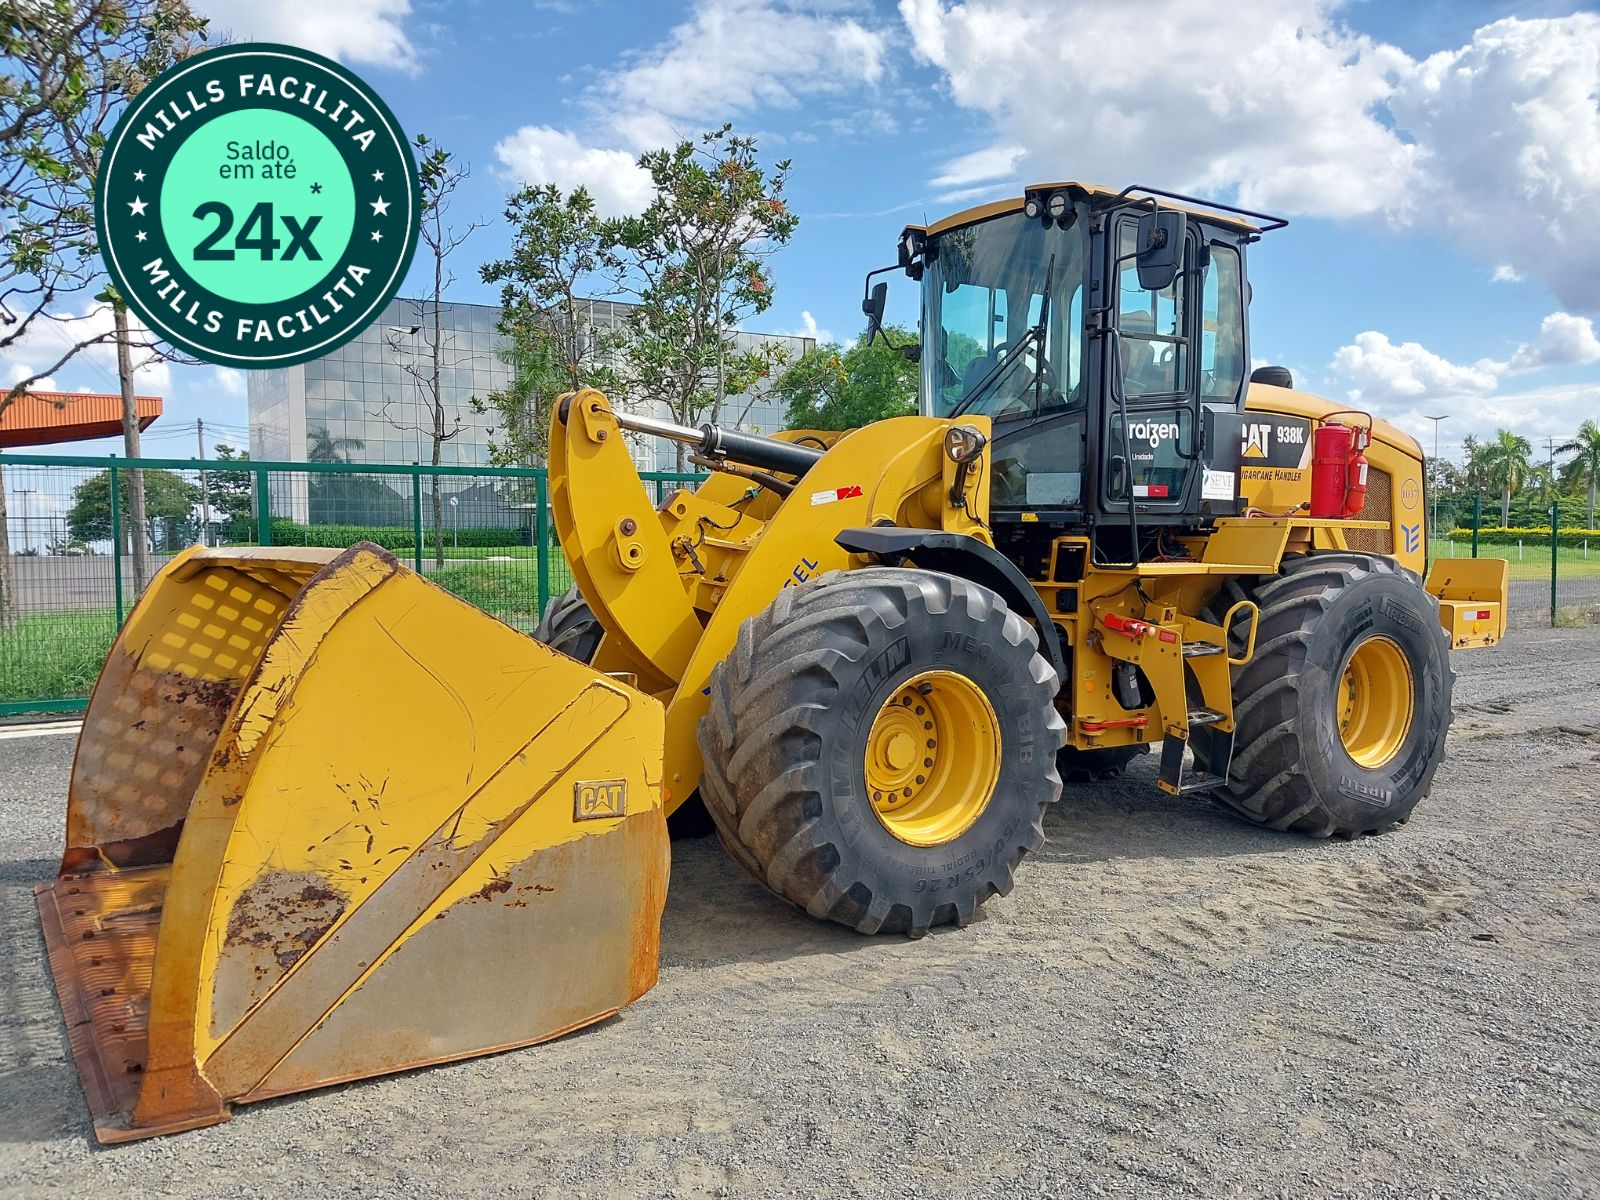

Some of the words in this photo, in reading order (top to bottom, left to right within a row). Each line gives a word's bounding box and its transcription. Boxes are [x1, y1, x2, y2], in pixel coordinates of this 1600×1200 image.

[1277, 426, 1304, 444] 938K
[1241, 470, 1273, 481] UGARCANE
[580, 785, 622, 815] CAT
